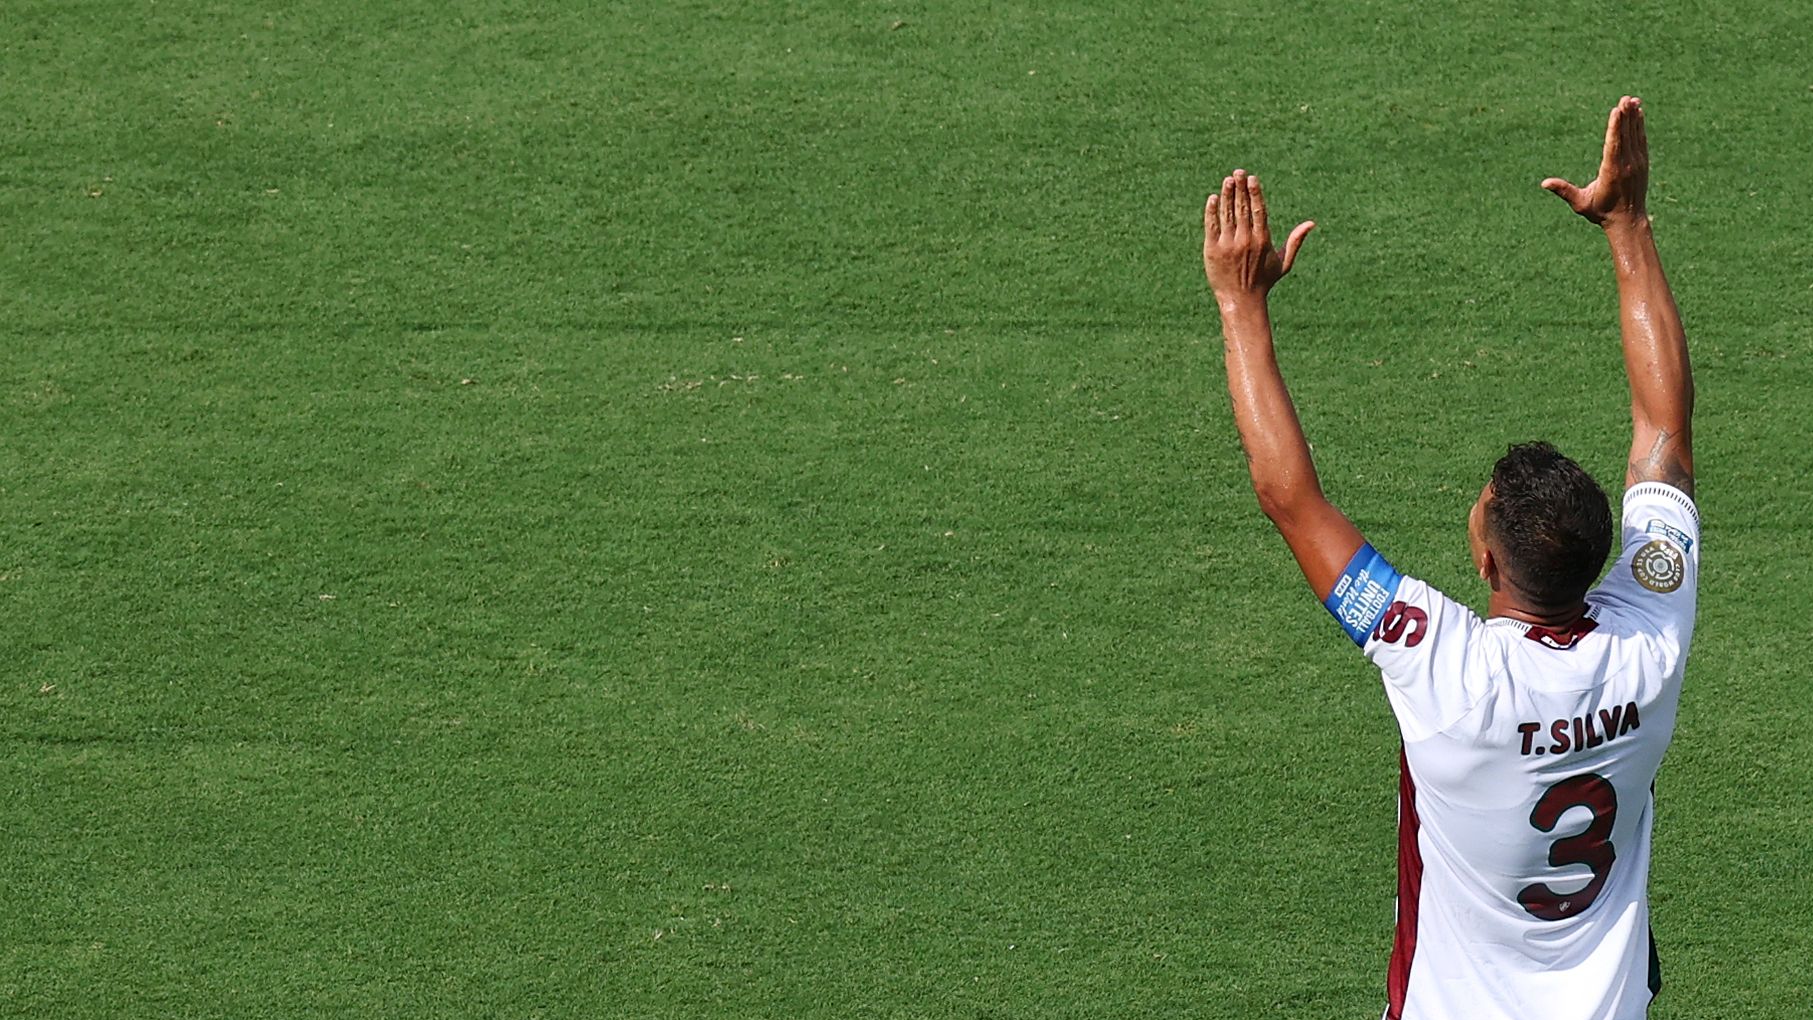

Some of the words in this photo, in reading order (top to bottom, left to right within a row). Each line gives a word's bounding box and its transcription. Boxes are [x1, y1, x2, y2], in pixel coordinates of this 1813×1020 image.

[1345, 580, 1381, 628] UNITES
[1356, 588, 1390, 633] FOOTBALL
[1517, 701, 1641, 756] T.SILVA
[1516, 772, 1618, 922] 3
